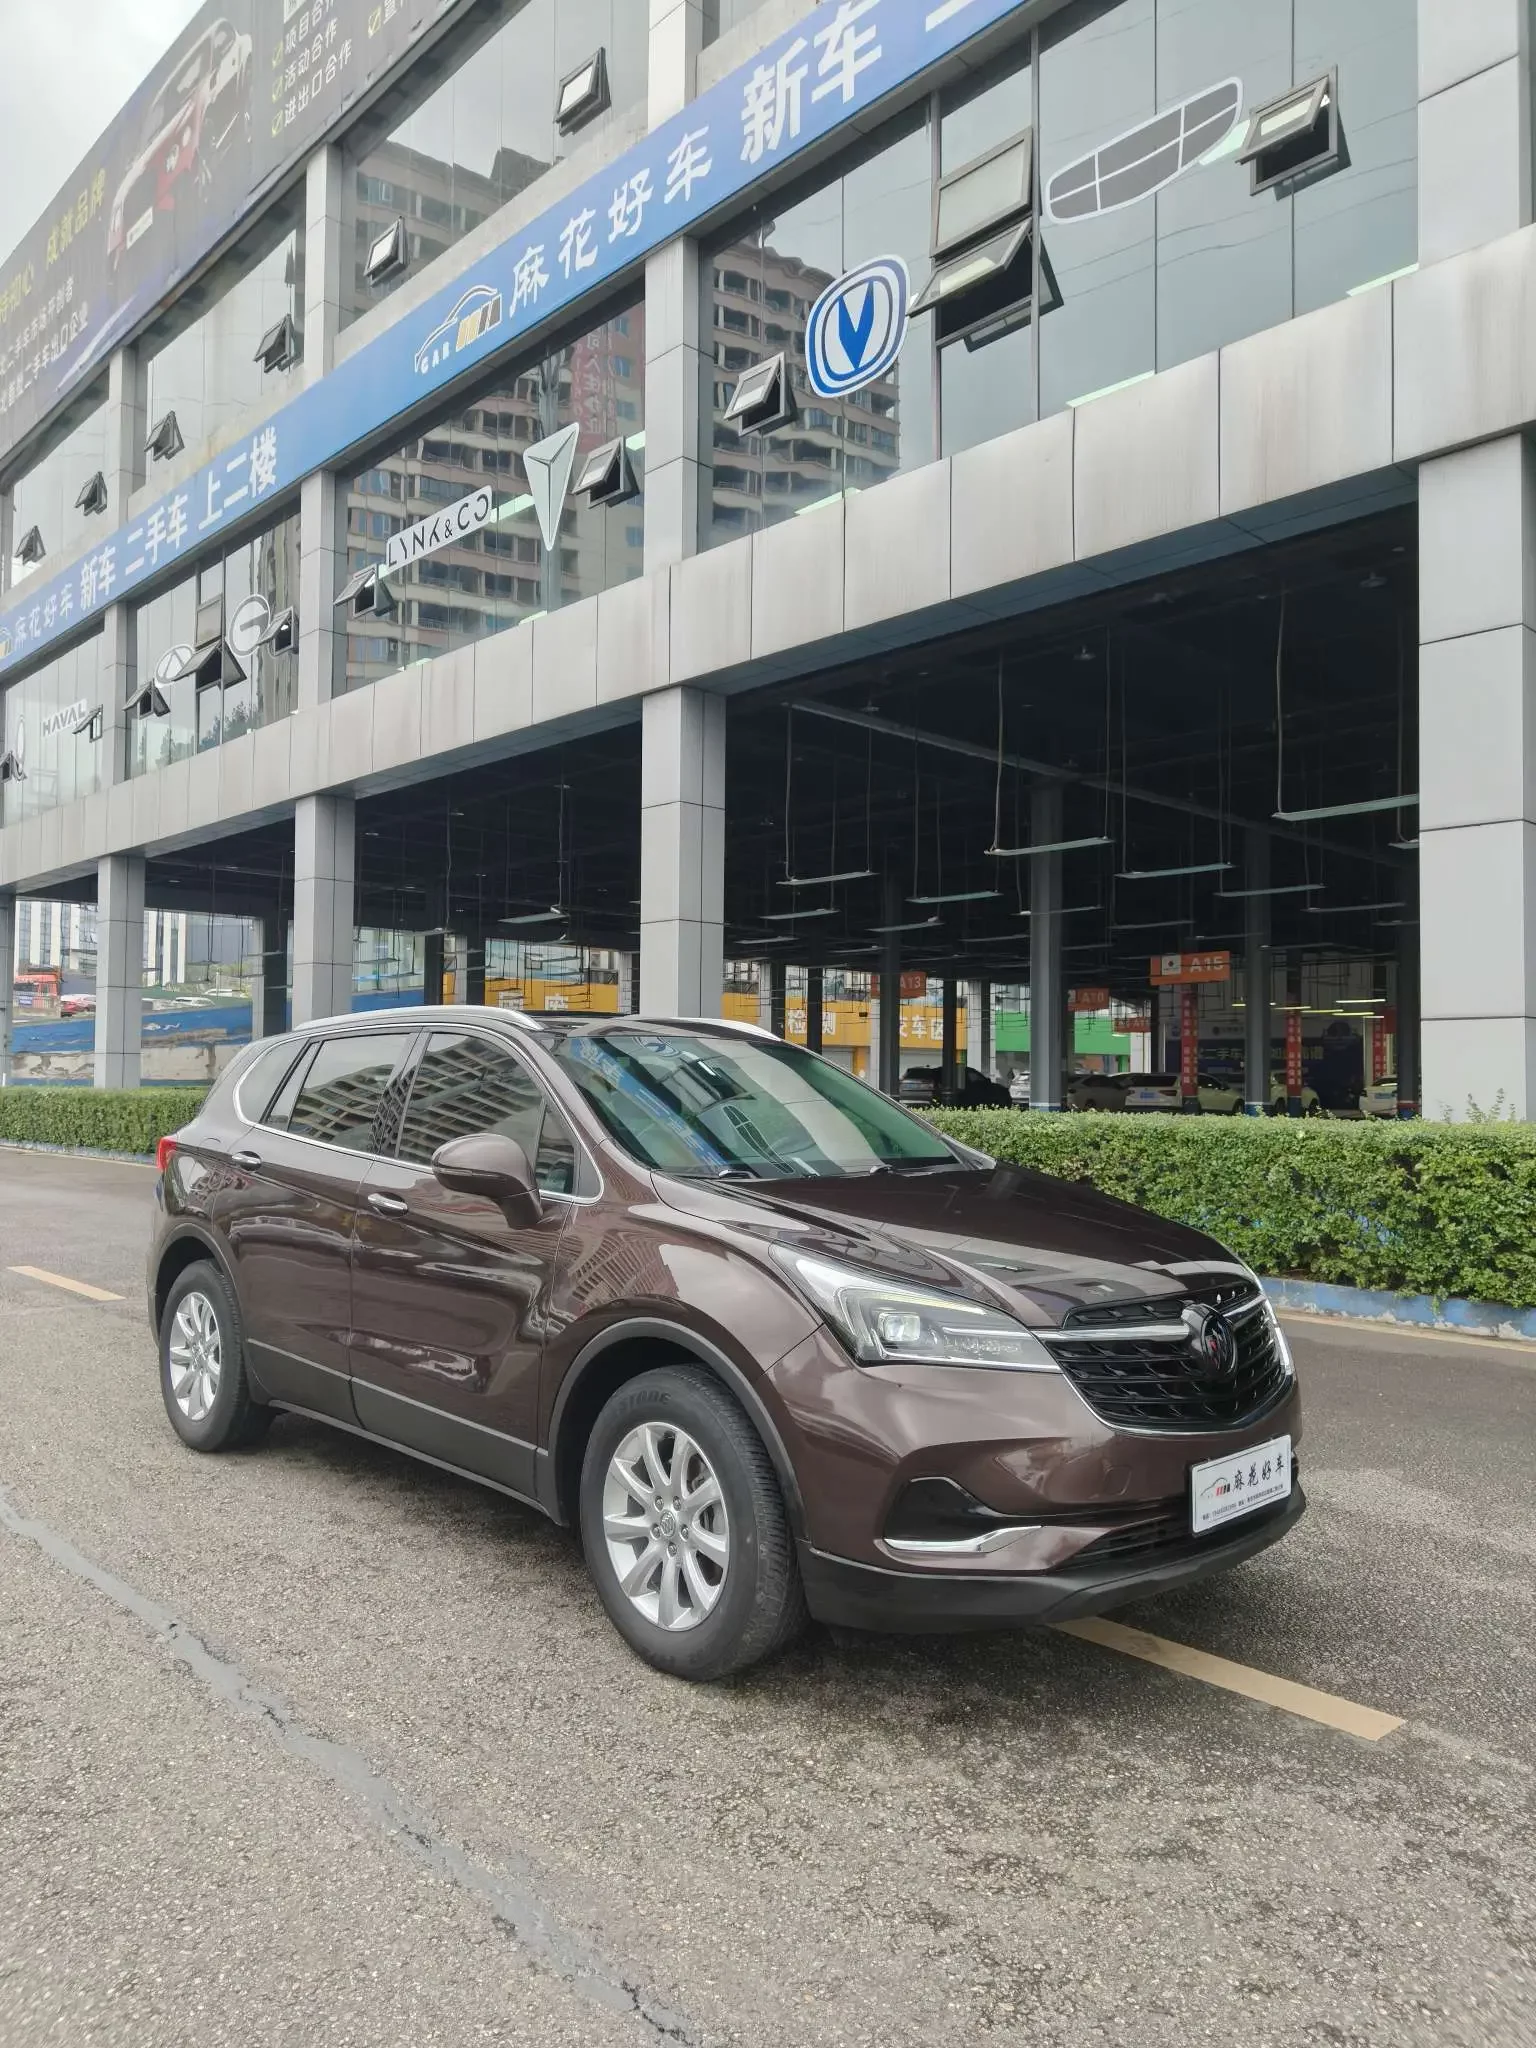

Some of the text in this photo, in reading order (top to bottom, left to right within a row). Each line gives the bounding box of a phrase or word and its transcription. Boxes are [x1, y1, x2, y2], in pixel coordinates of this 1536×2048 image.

[284, 17, 338, 92] 活动合作
[284, 38, 352, 127] 进出口合作
[508, 0, 882, 319] 麻花好车 新车
[45, 167, 106, 272] 成就品牌
[14, 425, 278, 652] 麻花好车 新车 二手车 上二楼
[42, 702, 87, 738] HAVAL
[1190, 955, 1225, 974] A15
[1232, 1452, 1285, 1491] 麻花好车
